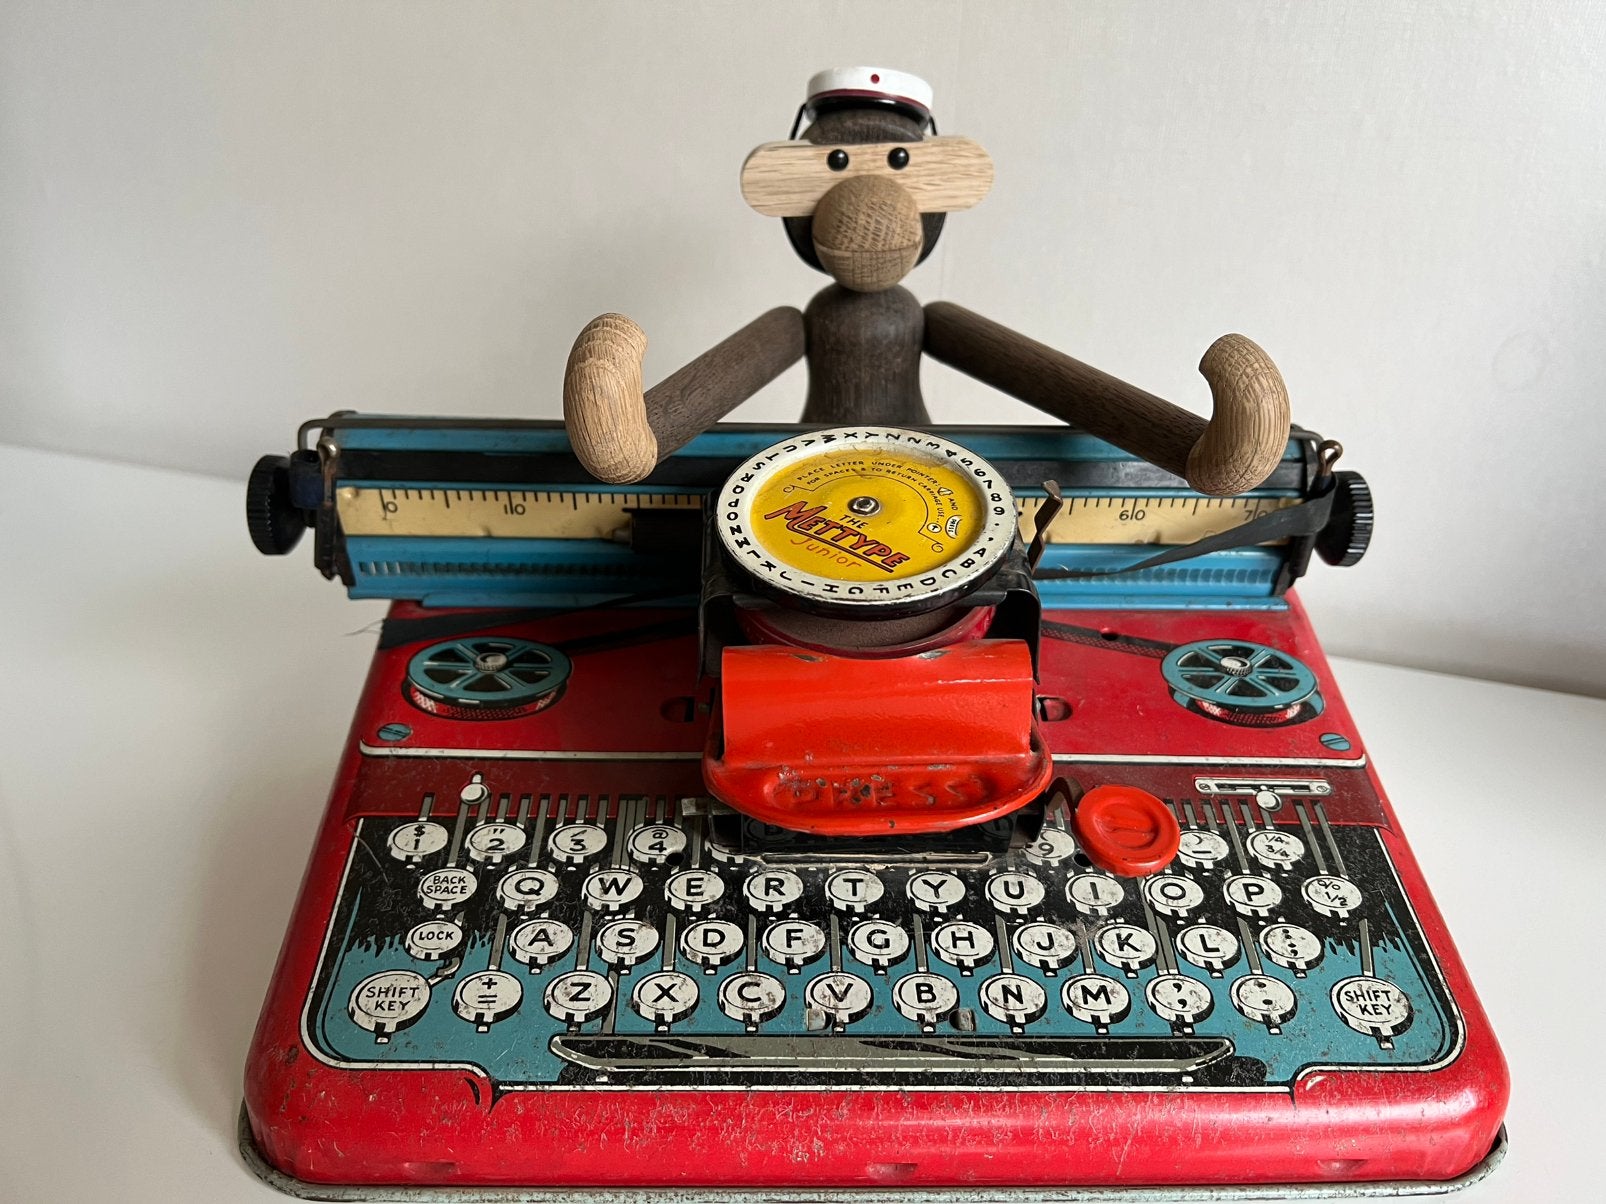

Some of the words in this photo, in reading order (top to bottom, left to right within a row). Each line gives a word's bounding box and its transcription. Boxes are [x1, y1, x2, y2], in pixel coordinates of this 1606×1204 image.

[820, 434, 837, 444] W
[865, 431, 879, 439] Y
[907, 436, 921, 444] 2
[782, 444, 797, 453] U
[925, 441, 941, 450] 3
[765, 452, 779, 461] T
[945, 449, 957, 458] 4
[752, 461, 766, 470] S
[960, 457, 974, 466] 5
[797, 466, 825, 481] PLACE
[830, 460, 865, 469] LETTER
[871, 461, 903, 469] UNDER
[973, 468, 986, 477] 6
[740, 472, 754, 482] R
[732, 485, 745, 494] Q
[807, 476, 820, 485] FOR
[825, 468, 858, 478] SPACES
[886, 468, 917, 483] RETURN
[918, 482, 943, 506] CARRIAGE
[983, 479, 993, 489] 7
[728, 498, 739, 507] P
[990, 493, 1002, 502] 8
[726, 511, 739, 521] O
[993, 506, 1005, 516] 9
[840, 514, 869, 529] THE
[729, 524, 743, 535] N
[734, 536, 751, 549] M
[746, 549, 762, 559] L
[790, 538, 862, 568] Junior
[973, 547, 987, 558] A
[760, 560, 777, 572] K
[959, 557, 976, 569] B
[779, 571, 792, 581] J
[941, 569, 958, 579] C
[822, 583, 839, 593] H
[896, 582, 914, 592] E
[919, 577, 937, 587] D
[847, 586, 864, 595] G
[414, 824, 425, 838] $
[651, 829, 669, 839] @
[413, 838, 420, 850] 1
[486, 837, 506, 851] 2
[569, 838, 587, 852] 3
[648, 840, 667, 853] 4
[1038, 842, 1054, 857] 9
[433, 875, 466, 884] BACK
[425, 885, 467, 894] SPACE
[515, 877, 544, 896] Q
[598, 877, 632, 896] W
[686, 878, 704, 896] E
[765, 878, 785, 896] R
[843, 879, 863, 896] T
[922, 880, 947, 898] Y
[1004, 881, 1024, 899] U
[1160, 883, 1186, 900] O
[1243, 883, 1264, 901] P
[418, 931, 455, 941] LOCK
[528, 929, 554, 946] A
[616, 928, 635, 949] S
[703, 929, 725, 949] D
[786, 929, 803, 948] F
[867, 929, 890, 949] G
[951, 931, 975, 948] H
[1036, 933, 1054, 950] J
[1116, 933, 1141, 952] K
[1199, 934, 1220, 952] L
[366, 986, 420, 999] SHIFT
[569, 982, 591, 1001] Z
[652, 983, 679, 1002] X
[738, 982, 761, 1002] C
[826, 983, 853, 1002] V
[916, 983, 936, 1003] B
[1002, 985, 1023, 1004] N
[1081, 985, 1111, 1004] M
[1344, 990, 1391, 1002] SHIFT
[374, 1000, 411, 1011] KEY
[1359, 1004, 1392, 1015] KEY
